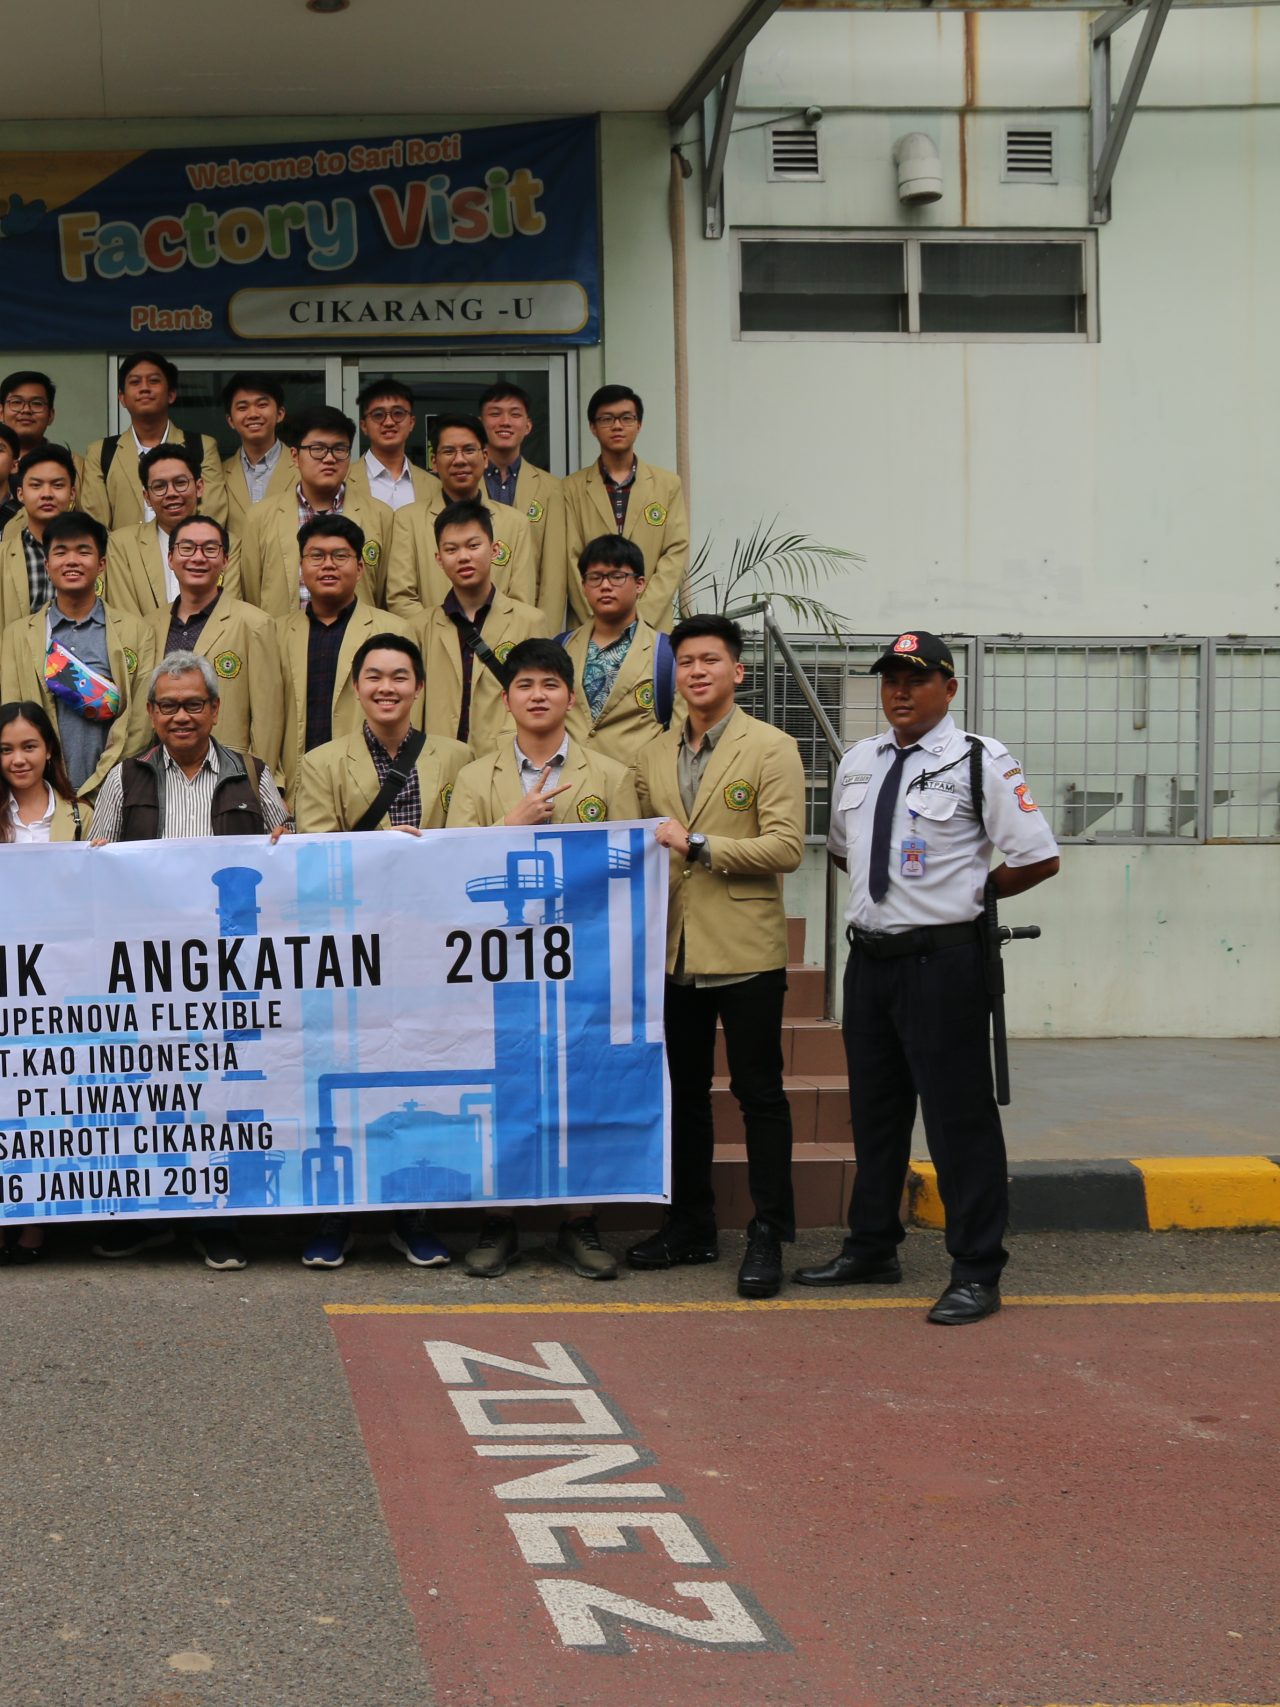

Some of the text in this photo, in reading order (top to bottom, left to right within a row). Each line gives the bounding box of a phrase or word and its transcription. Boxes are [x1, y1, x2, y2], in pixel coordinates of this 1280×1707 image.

[186, 133, 461, 191] Welcome to Sari Roti
[58, 166, 546, 282] Factory Visit
[131, 305, 213, 333] Plant:
[289, 298, 484, 324] CIKARANG
[108, 933, 381, 994] ANGKATAN
[445, 925, 572, 984] 2018
[152, 1001, 282, 1031] FLEXIBLE
[89, 1043, 238, 1073] INDONESIA
[18, 1084, 202, 1117] PT.LIWAYWAY
[133, 1122, 273, 1154] CIKARANG
[36, 1168, 151, 1202] JANUARI
[163, 1166, 228, 1195] 2019
[423, 1340, 767, 1646] ZONE 2
